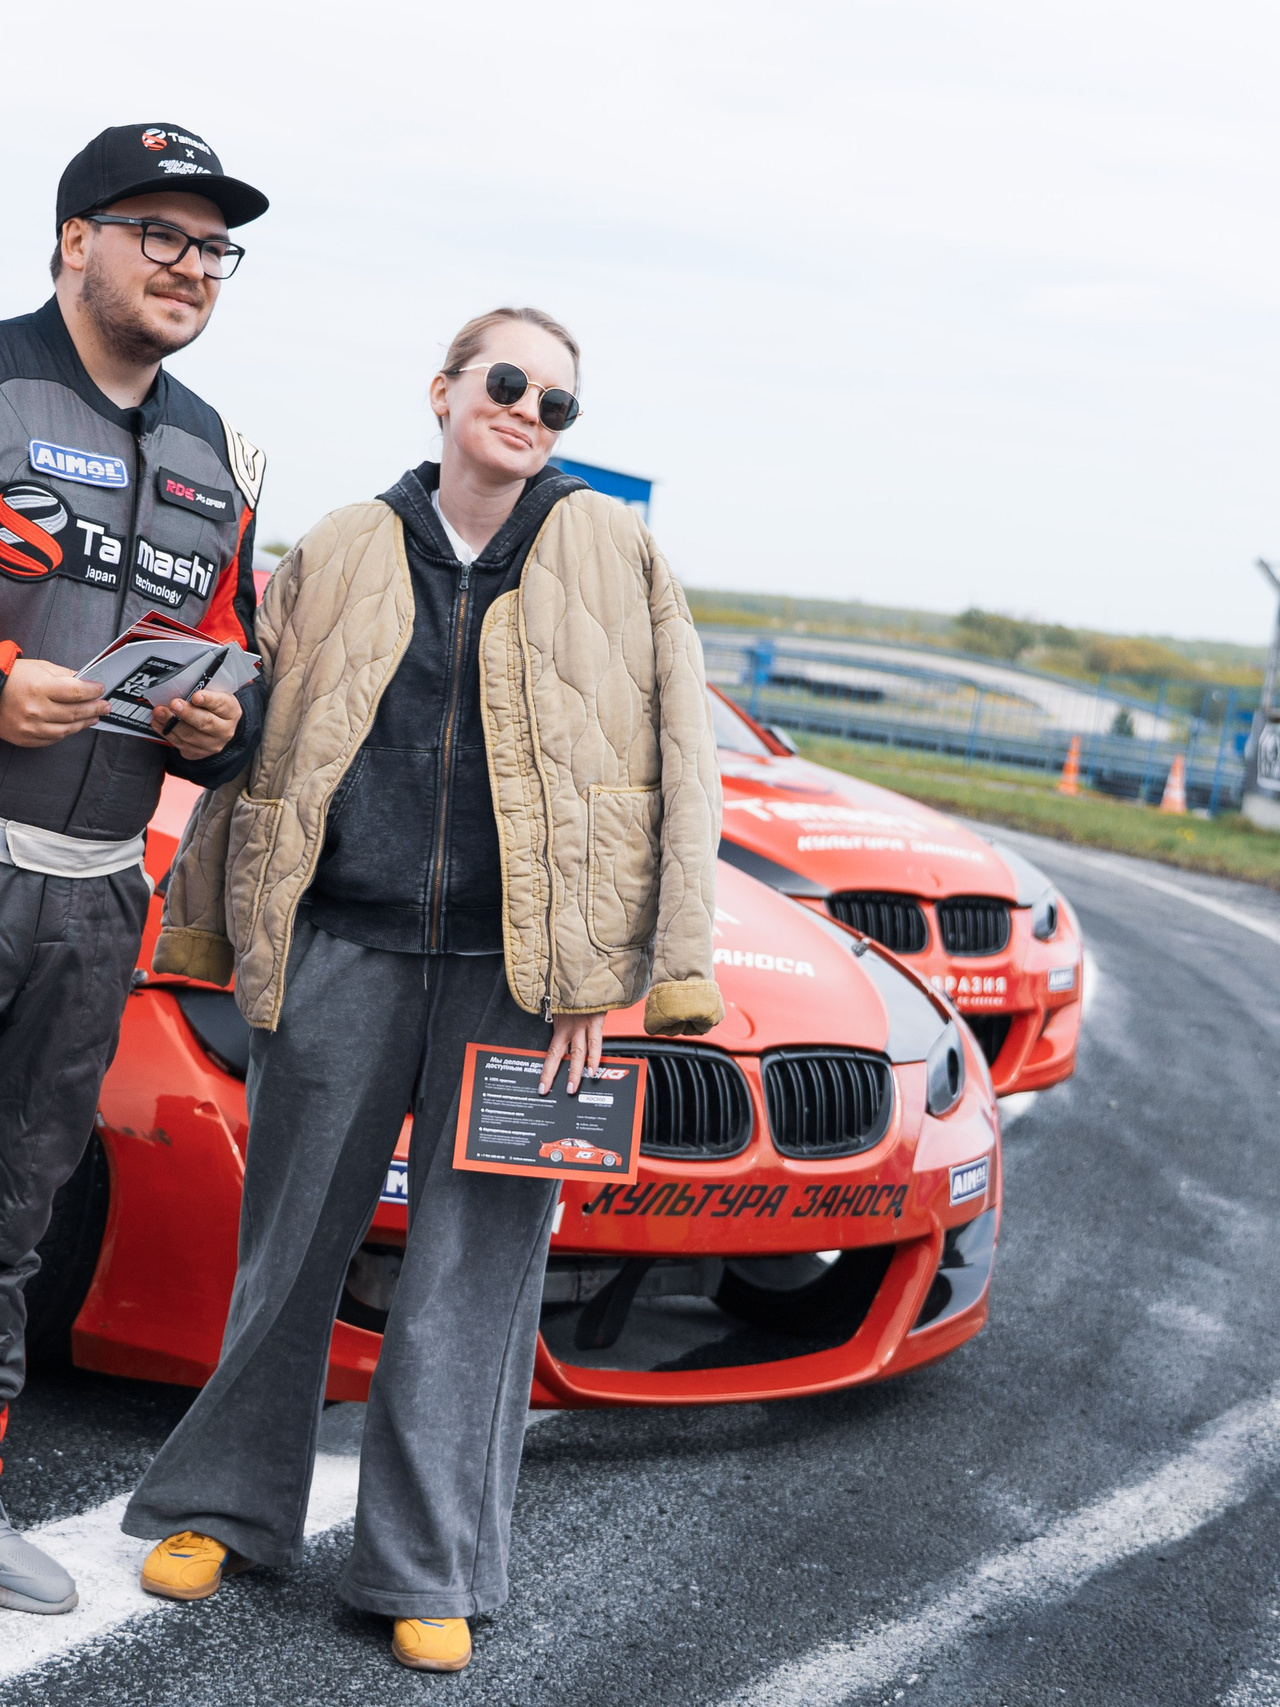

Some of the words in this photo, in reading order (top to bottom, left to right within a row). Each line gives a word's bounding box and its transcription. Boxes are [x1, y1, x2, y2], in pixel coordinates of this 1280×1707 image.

[36, 447, 122, 481] AIMOL
[135, 573, 182, 604] technology
[712, 948, 815, 978] АНОСА
[588, 1183, 788, 1217] КУЛЬТУРА
[791, 1184, 909, 1217] ЗАНОСА
